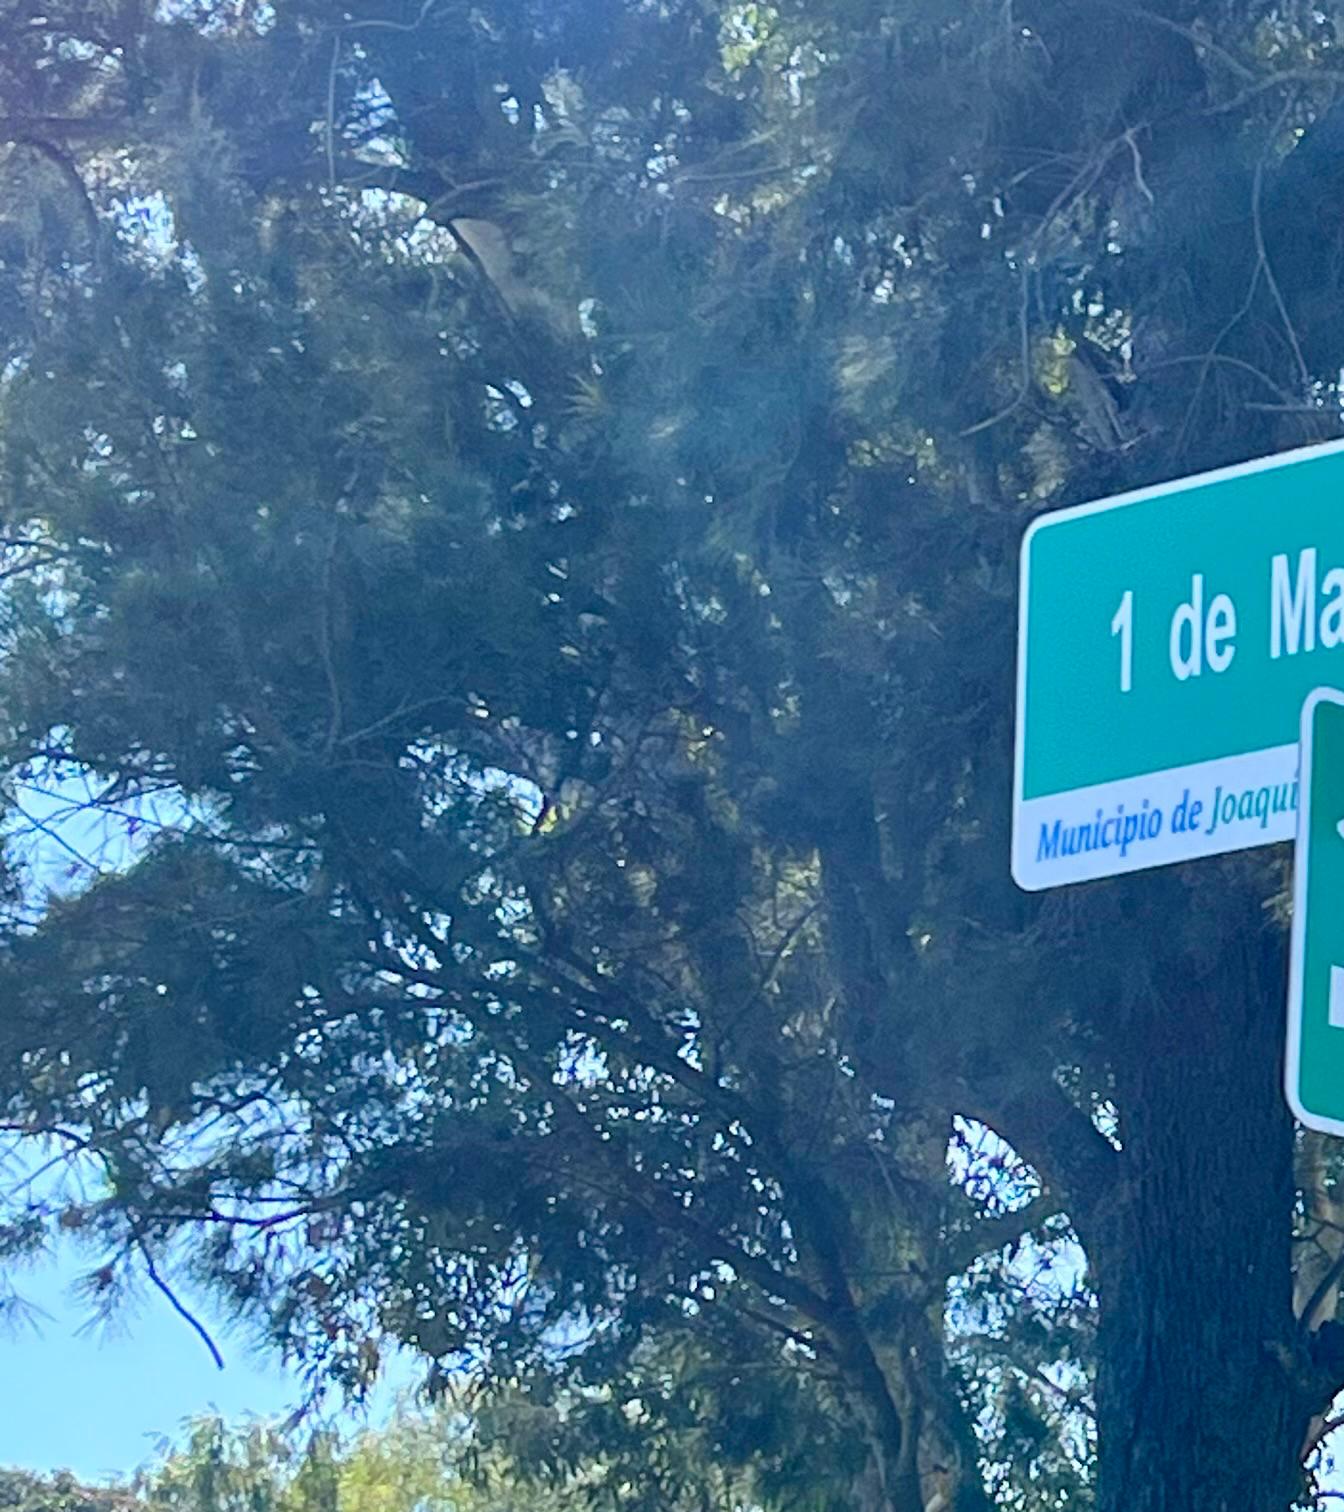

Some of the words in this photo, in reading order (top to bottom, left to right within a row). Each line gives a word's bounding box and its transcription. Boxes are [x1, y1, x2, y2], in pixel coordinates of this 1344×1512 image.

[1111, 590, 1133, 692] 1
[1169, 574, 1236, 680] de
[1037, 799, 1162, 861] Municipio
[1171, 788, 1202, 833] de
